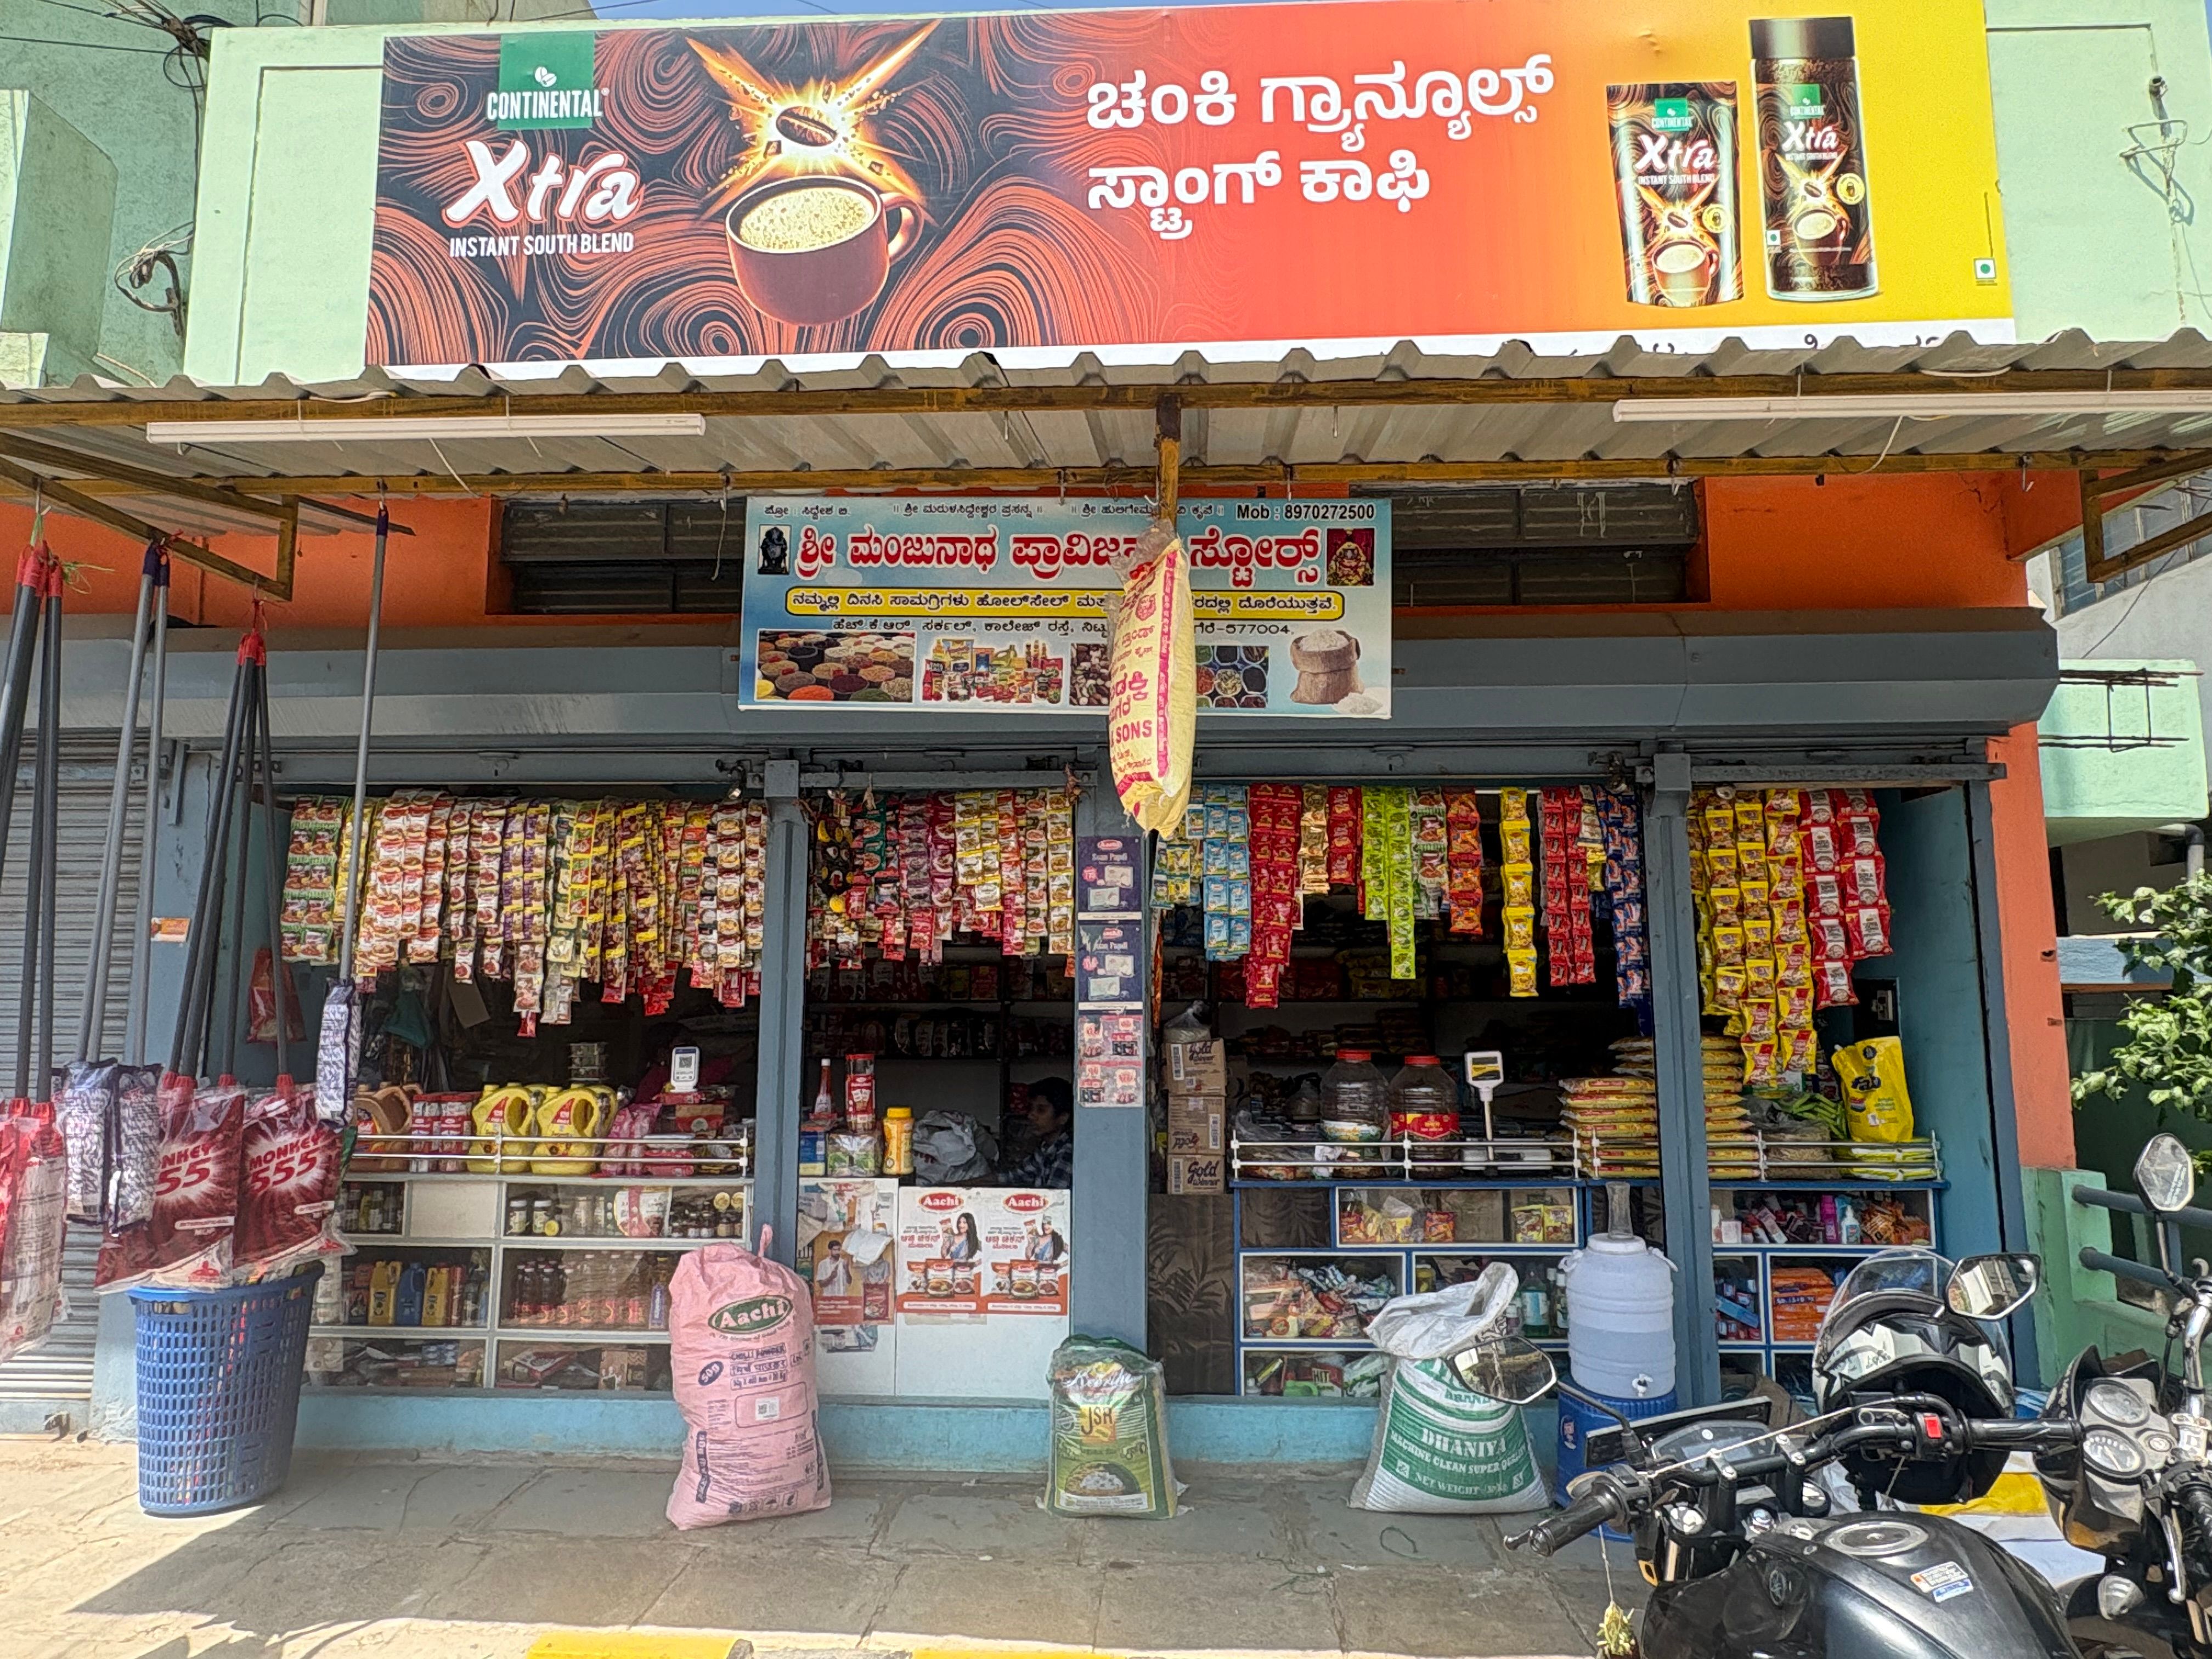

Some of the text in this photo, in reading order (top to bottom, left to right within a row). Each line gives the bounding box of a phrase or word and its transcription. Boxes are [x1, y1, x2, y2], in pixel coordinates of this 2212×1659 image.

[487, 91, 602, 121] CONTINENTAL
[1087, 69, 1237, 128] ಚಂಕಿ
[1782, 121, 1838, 151] Xtra
[1634, 134, 1716, 172] Xtra
[444, 140, 641, 222] Xtra
[1088, 149, 1430, 240] ಸ್ಟ್ರಾಂಗ್ ಕಾಫಿ
[1638, 175, 1667, 184] INSTANT
[450, 233, 634, 257] INSTANT SOUTH BLEND
[1237, 504, 1270, 520] Mob
[1284, 505, 1374, 520] 8970272500
[798, 527, 836, 577] ಶ್ರೀ
[850, 525, 997, 572] ಮಂಜುನಾಥ
[847, 594, 883, 606] ದಿನಸಿ
[1116, 719, 1152, 744] SONS
[161, 1141, 216, 1169] NKEY
[249, 1131, 326, 1171] MONKEY
[156, 1156, 212, 1197] 55
[251, 1148, 320, 1198] 555
[1187, 1159, 1221, 1184] Gold
[923, 1196, 959, 1206] Aachi
[1008, 1197, 1045, 1207] Aachi
[720, 1298, 786, 1329] Aachi
[1390, 1430, 1431, 1463] MACHINE
[1433, 1455, 1466, 1474] CLEAN
[1468, 1462, 1500, 1474] SUPER
[1421, 1427, 1506, 1458] DHANIYA
[1415, 1471, 1436, 1488] NET
[1437, 1481, 1481, 1495] WEIGHT
